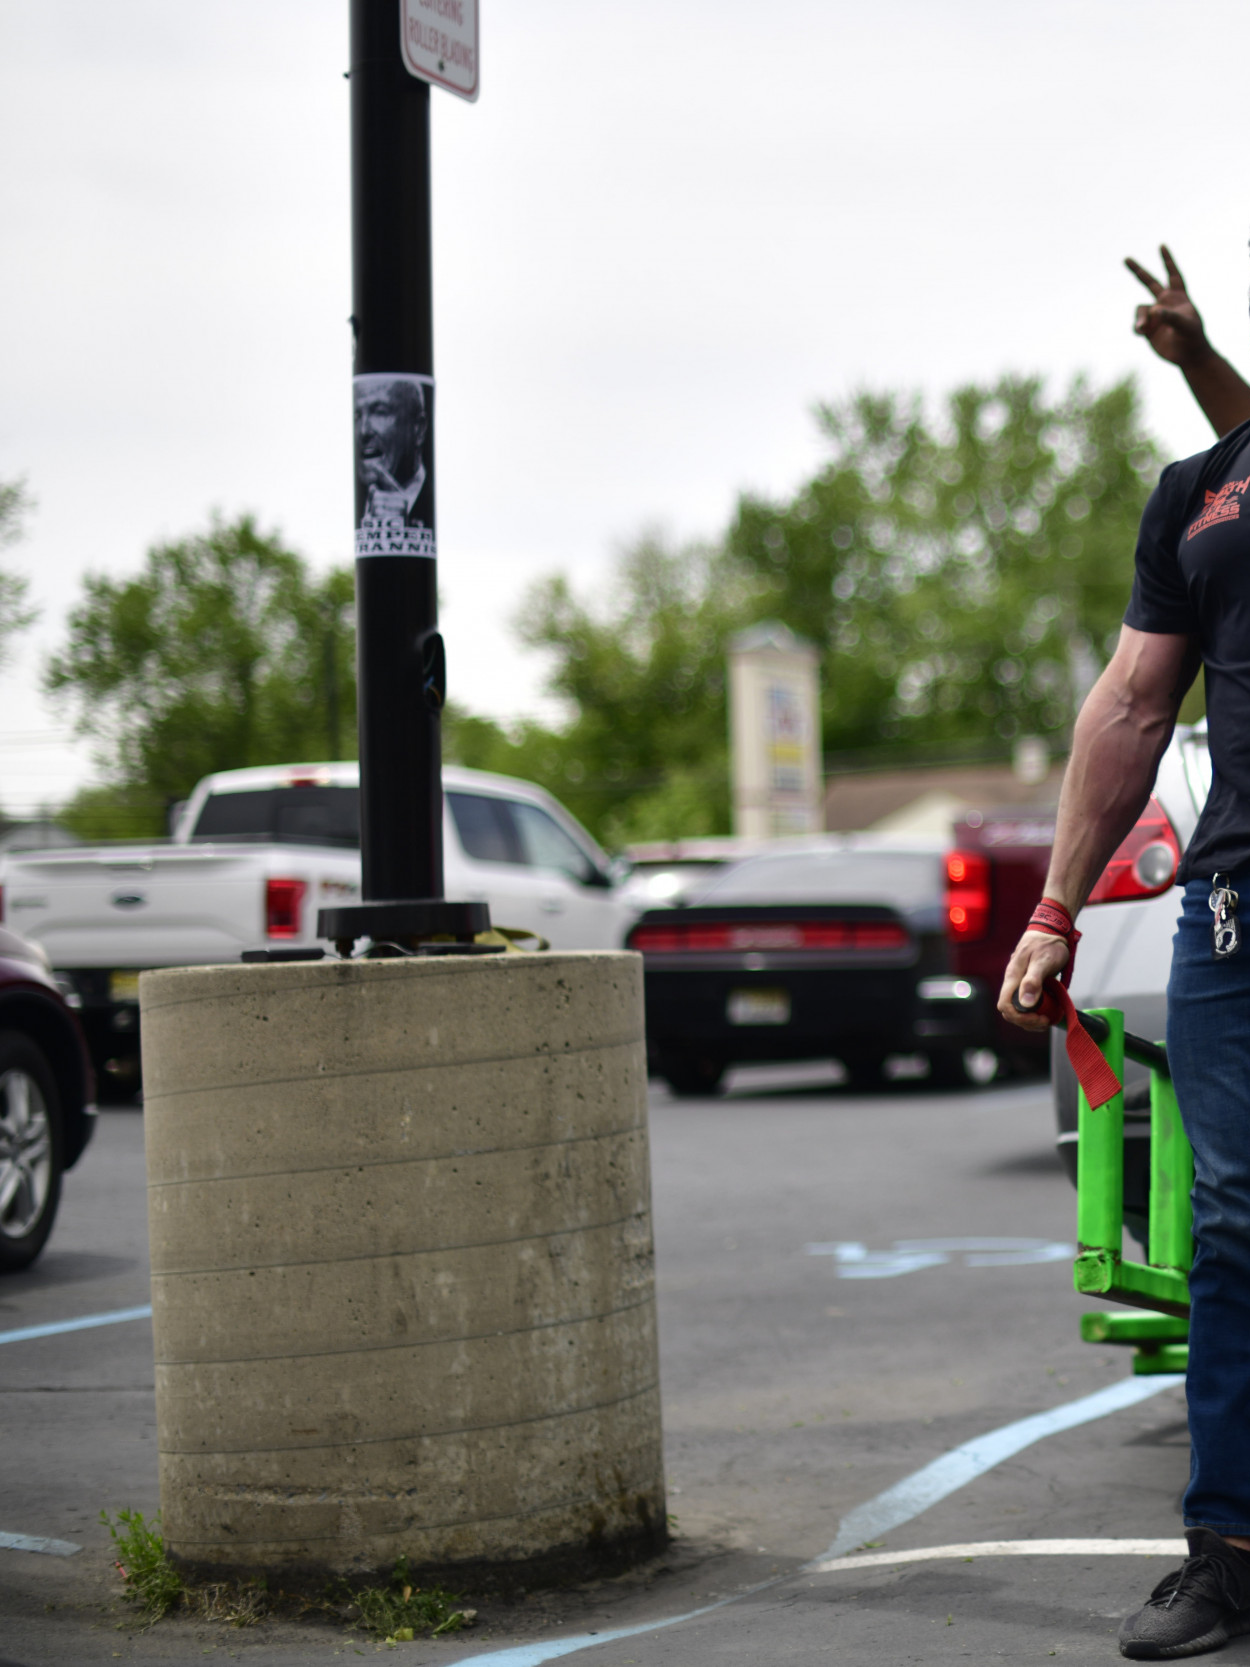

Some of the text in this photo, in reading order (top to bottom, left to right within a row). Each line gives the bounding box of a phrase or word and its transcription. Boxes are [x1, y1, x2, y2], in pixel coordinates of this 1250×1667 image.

[363, 519, 402, 529] SIC
[1188, 503, 1240, 537] FITNESS
[355, 531, 431, 541] EMPER
